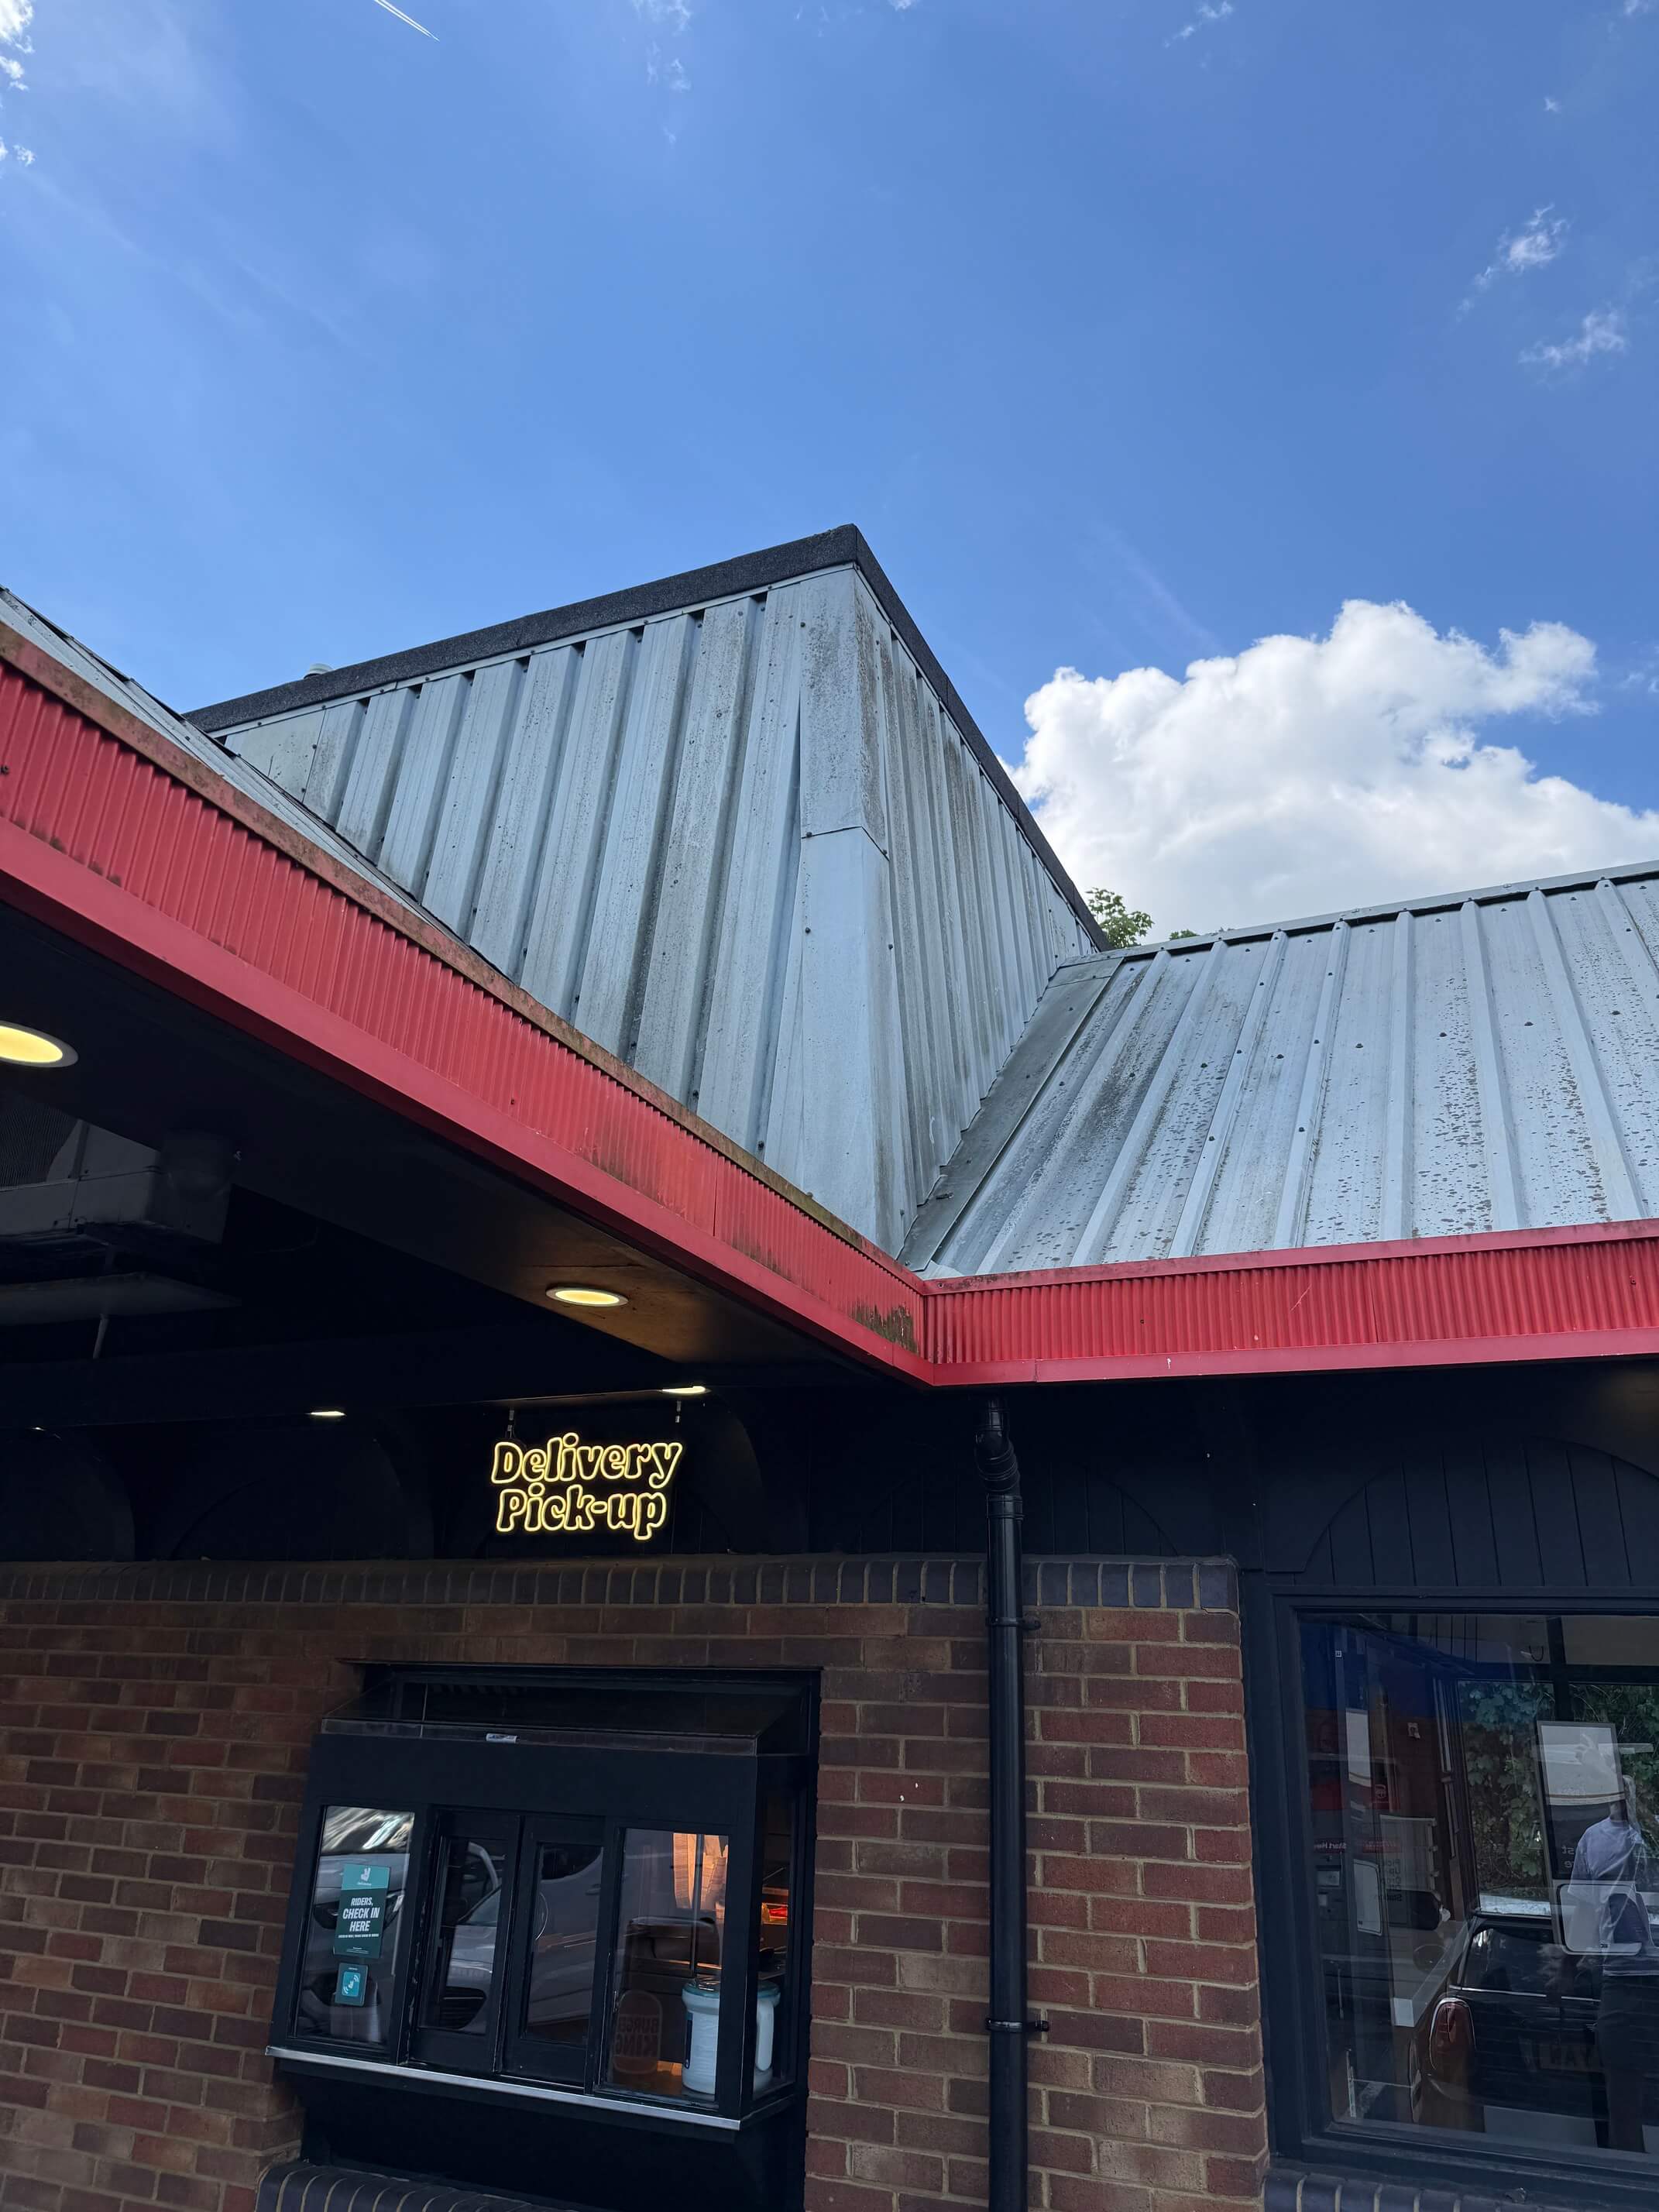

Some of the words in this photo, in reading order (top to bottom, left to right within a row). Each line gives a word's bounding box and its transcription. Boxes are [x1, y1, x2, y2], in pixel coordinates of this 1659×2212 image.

[490, 1432, 683, 1489] Delivery
[496, 1482, 668, 1540] Pick-up
[350, 1896, 373, 1907] RIDERS,
[342, 1908, 369, 1920] CHECK
[370, 1907, 381, 1918] IN
[349, 1920, 371, 1932] HERE
